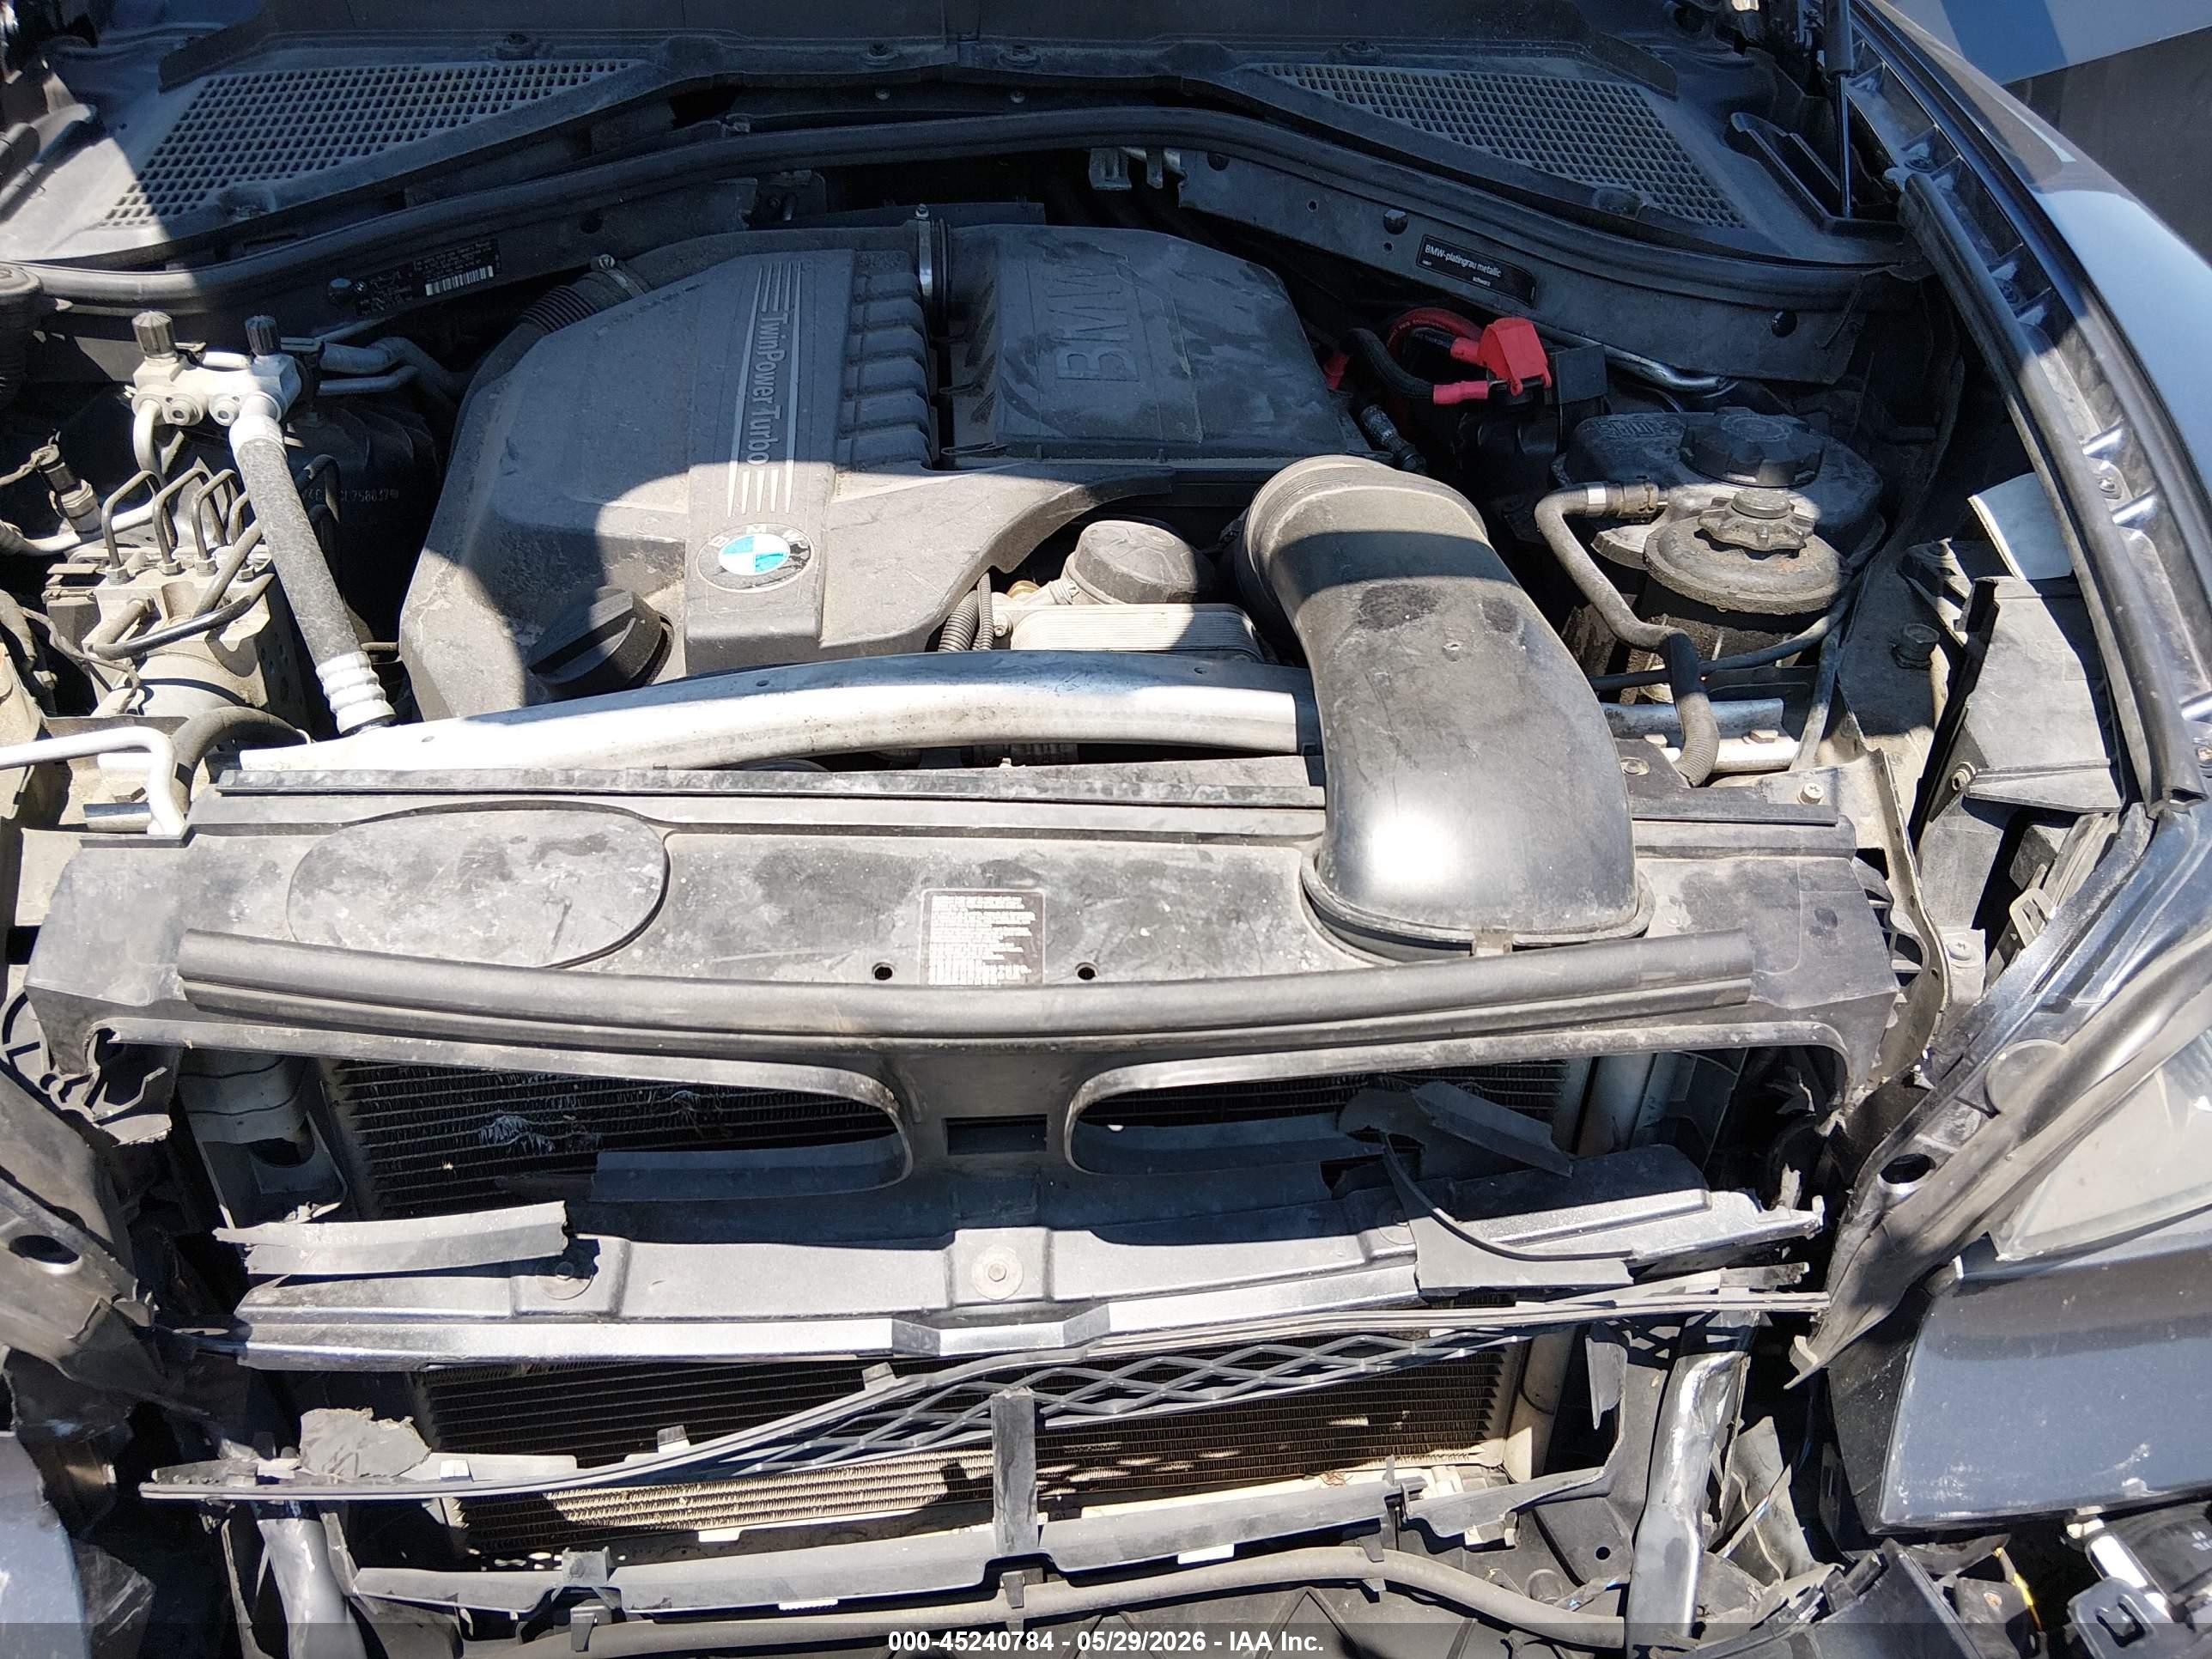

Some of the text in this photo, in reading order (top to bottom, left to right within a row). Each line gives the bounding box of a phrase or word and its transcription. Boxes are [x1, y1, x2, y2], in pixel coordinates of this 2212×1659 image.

[1476, 263, 1502, 278] metallic
[1042, 263, 1140, 383] BMW
[747, 313, 790, 465] TwinPower Turbo
[707, 524, 804, 549] BMW
